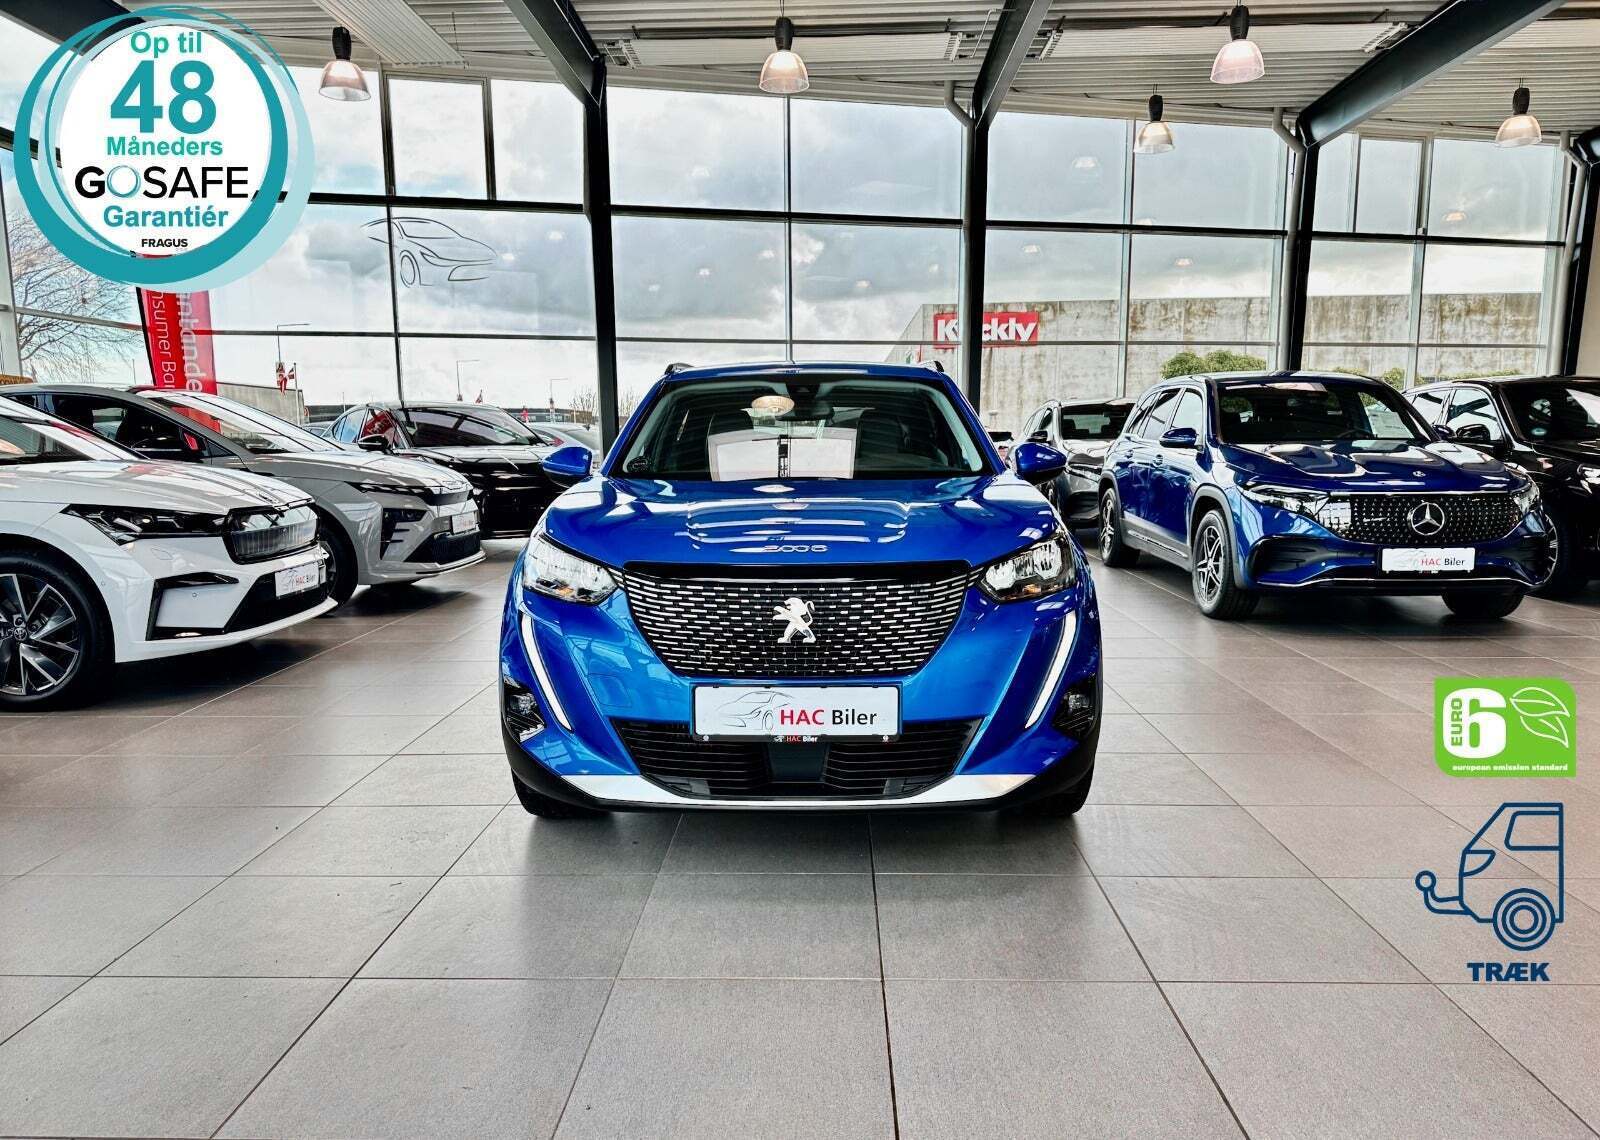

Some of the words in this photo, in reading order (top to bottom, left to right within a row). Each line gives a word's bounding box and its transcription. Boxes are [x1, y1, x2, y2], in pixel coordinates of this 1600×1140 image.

[1421, 558, 1441, 566] HAC
[1444, 557, 1466, 566] Biler
[780, 709, 825, 725] HAC
[831, 708, 878, 725] Biler
